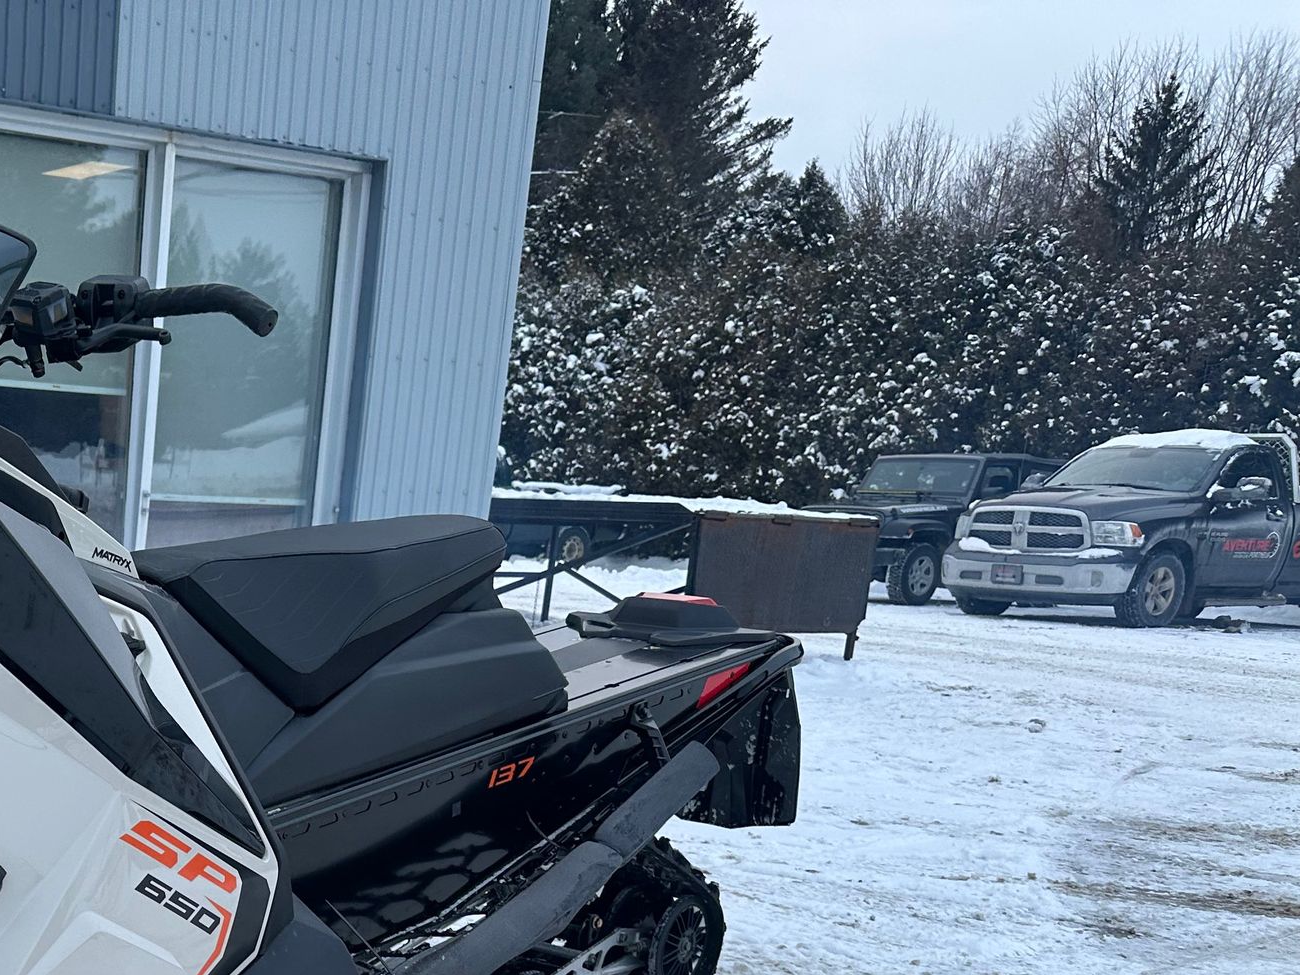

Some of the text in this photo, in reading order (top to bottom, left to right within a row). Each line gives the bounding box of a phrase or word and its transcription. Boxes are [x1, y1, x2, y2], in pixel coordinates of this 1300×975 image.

[91, 546, 132, 573] MATRYX
[488, 756, 535, 789] 137
[119, 820, 237, 894] SP
[134, 873, 221, 935] 650
